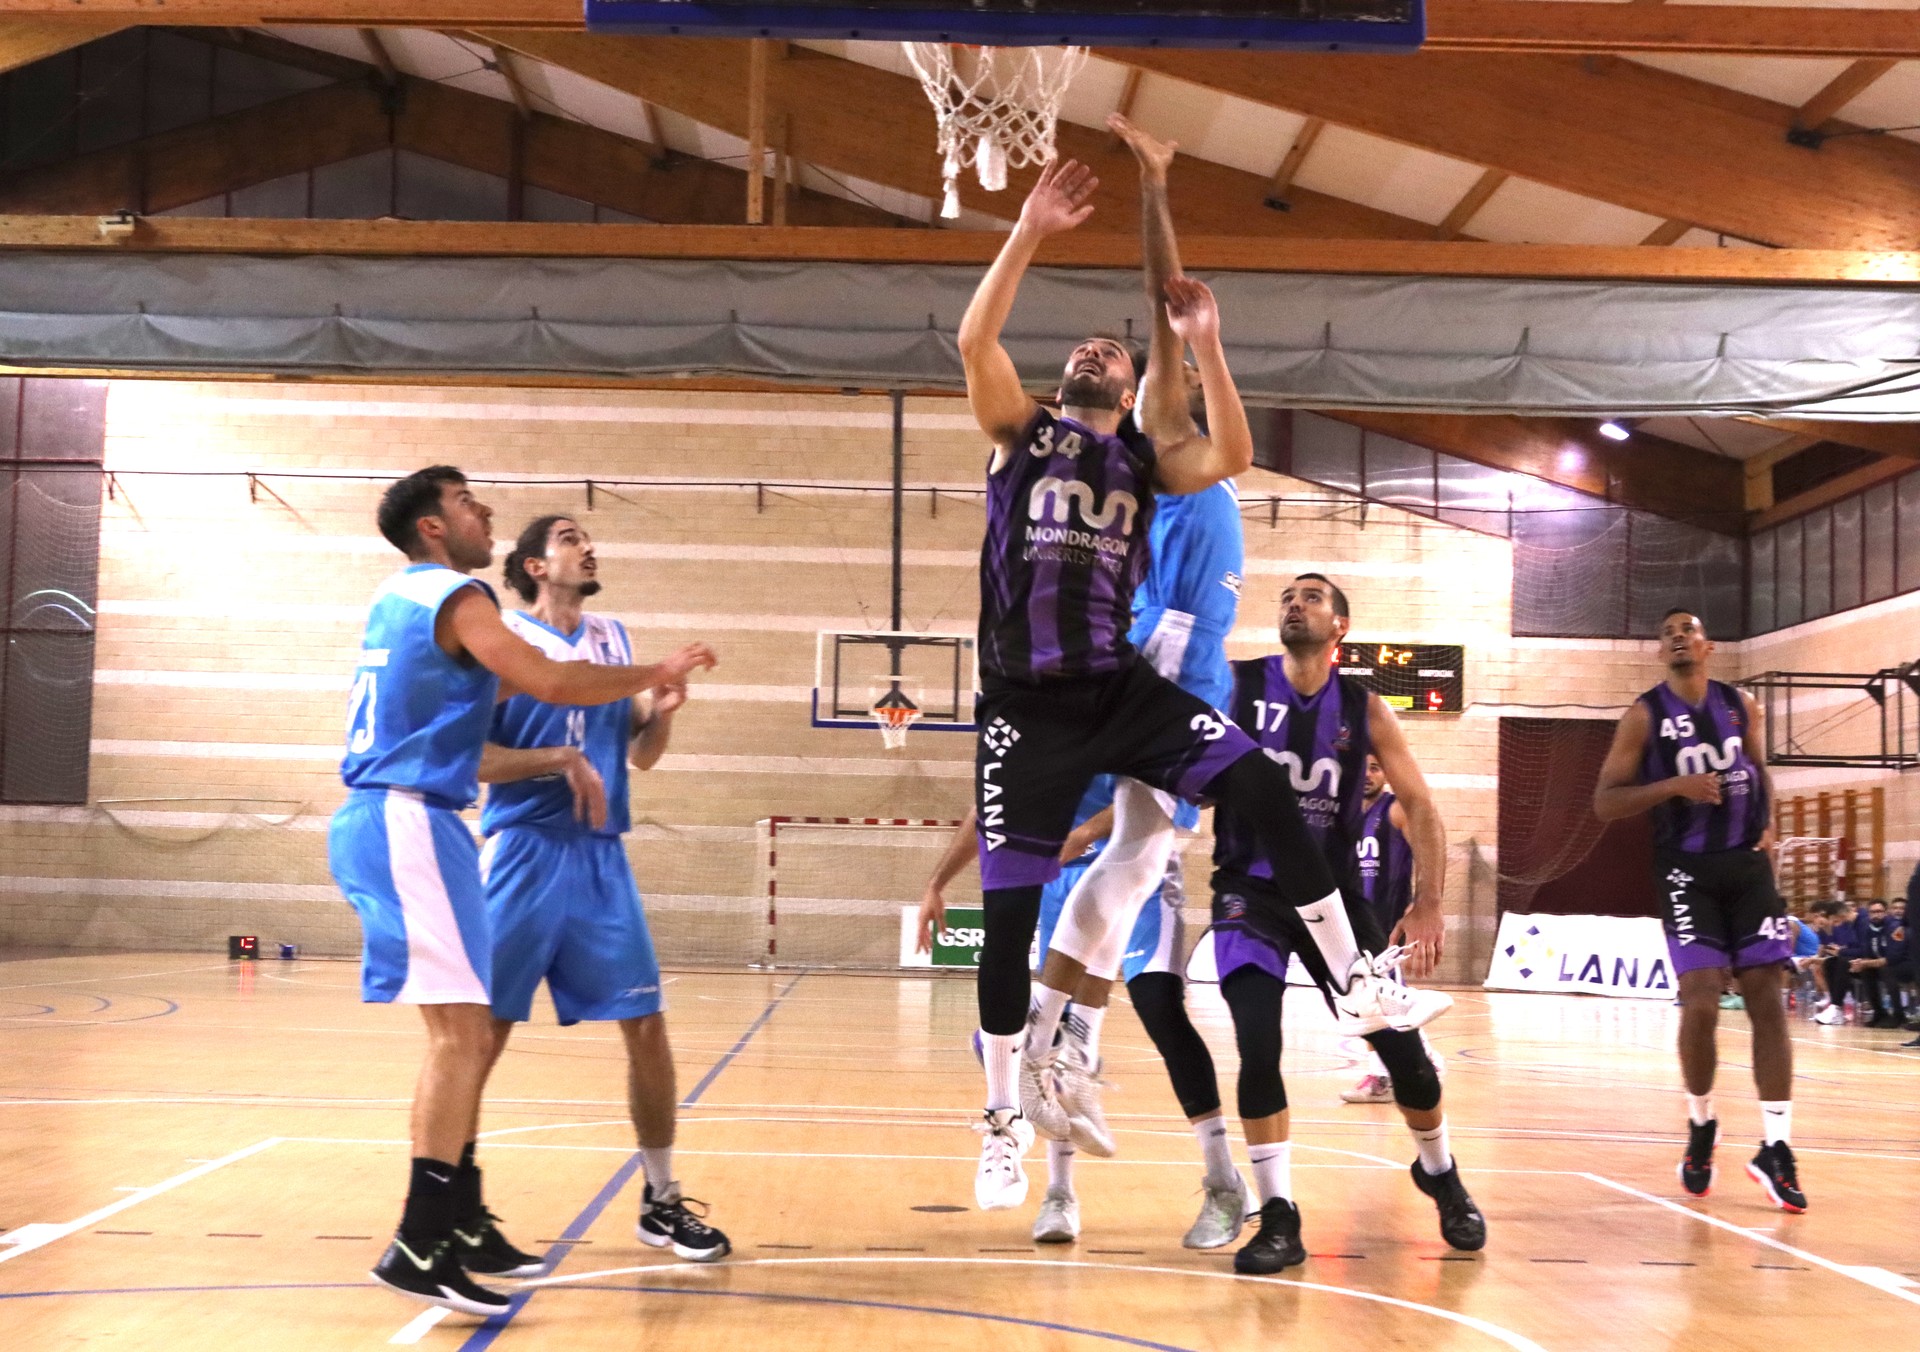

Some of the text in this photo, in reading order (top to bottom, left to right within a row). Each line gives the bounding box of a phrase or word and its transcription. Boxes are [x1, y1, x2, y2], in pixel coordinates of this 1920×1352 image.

[1029, 426, 1081, 460] 34
[1025, 525, 1130, 557] MONDRAGON
[1253, 700, 1289, 733] 17
[1660, 714, 1696, 740] 45
[983, 762, 1007, 852] LANA
[1669, 889, 1697, 947] LANA
[1757, 916, 1790, 941] 45
[1558, 953, 1671, 990] LANA
